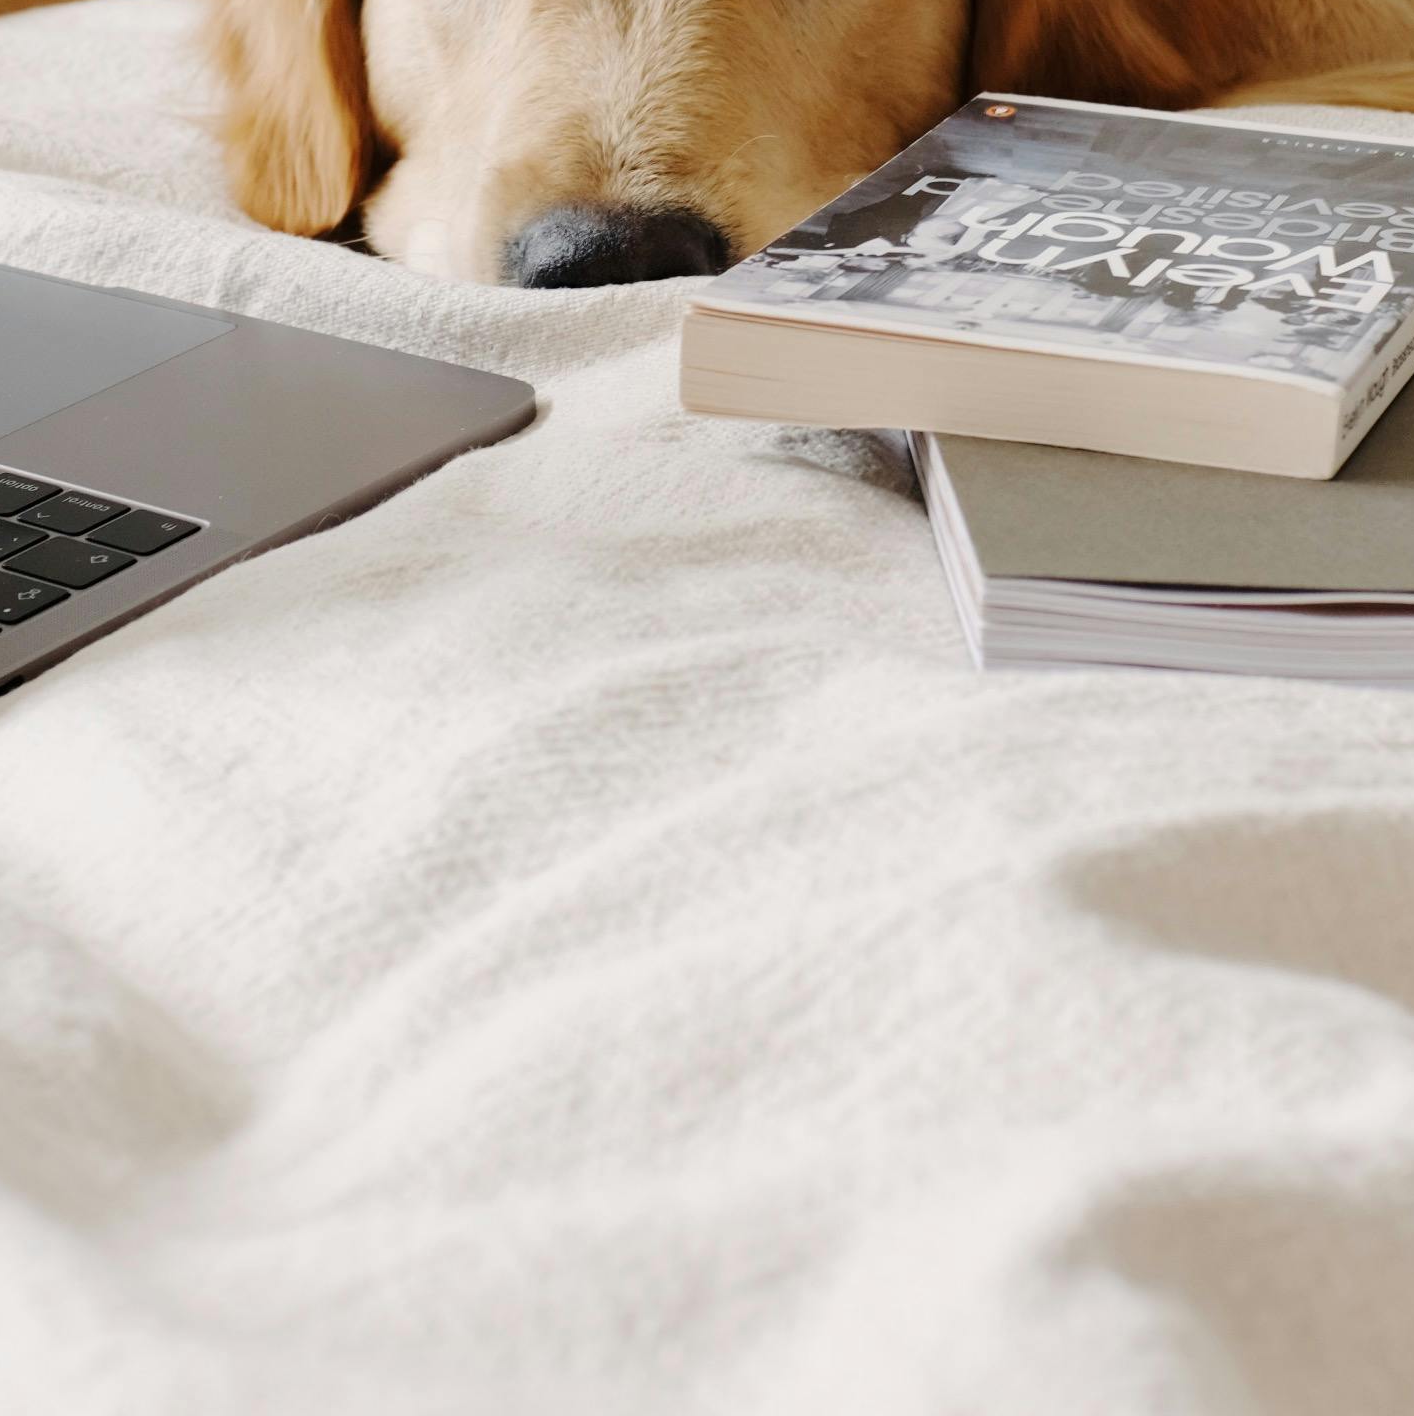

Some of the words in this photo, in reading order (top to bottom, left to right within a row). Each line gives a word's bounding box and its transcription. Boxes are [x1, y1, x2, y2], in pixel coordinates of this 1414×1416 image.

[958, 205, 1394, 284] Waugh
[977, 238, 1394, 314] Evelyn
[62, 496, 111, 513] control
[160, 522, 178, 532] fn
